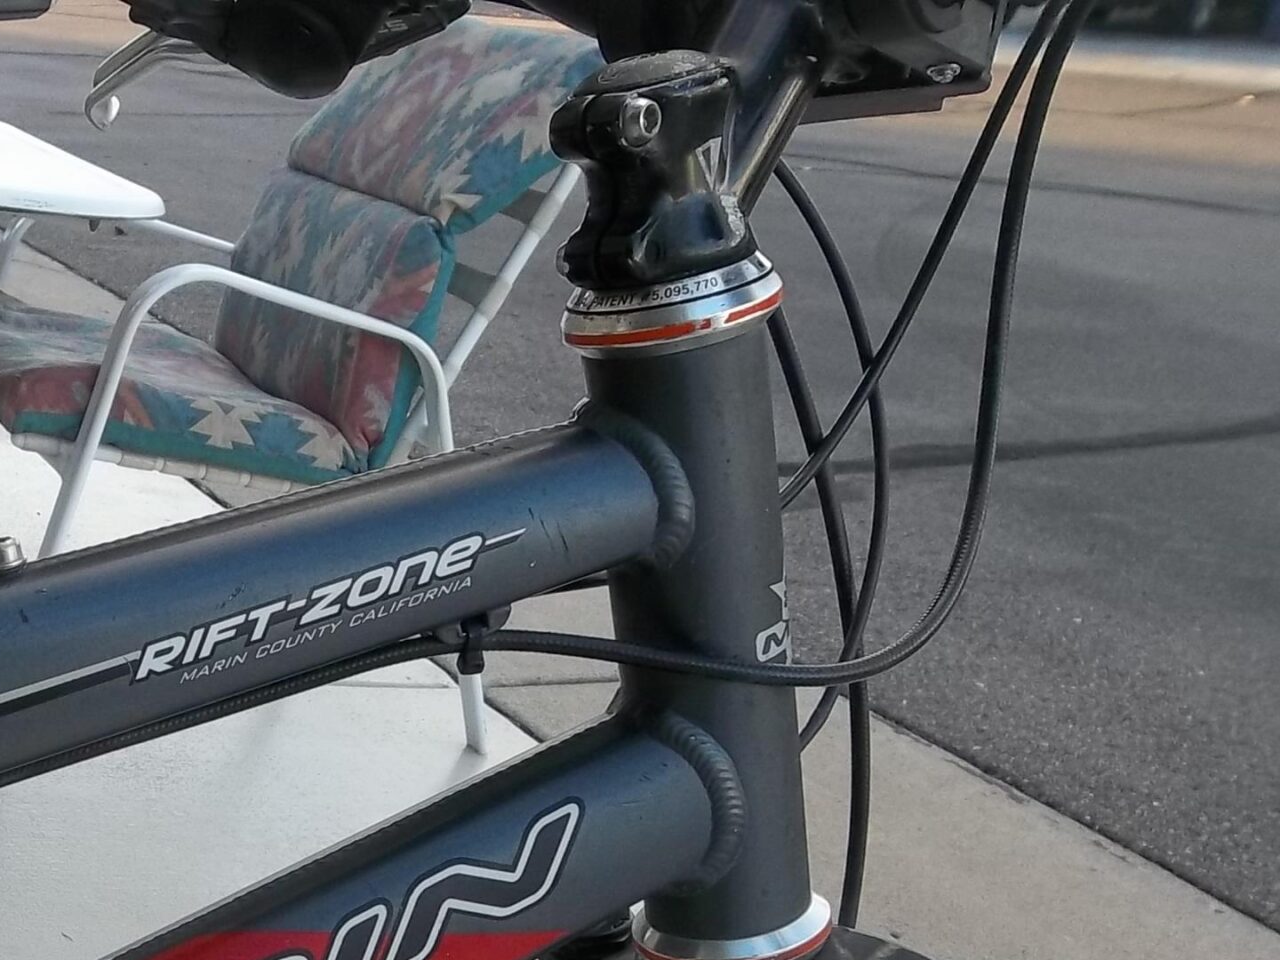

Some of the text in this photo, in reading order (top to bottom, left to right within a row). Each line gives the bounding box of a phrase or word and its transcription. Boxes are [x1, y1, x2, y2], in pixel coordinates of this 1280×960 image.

[179, 576, 472, 684] MARIN COUNTY CALIFORNIA
